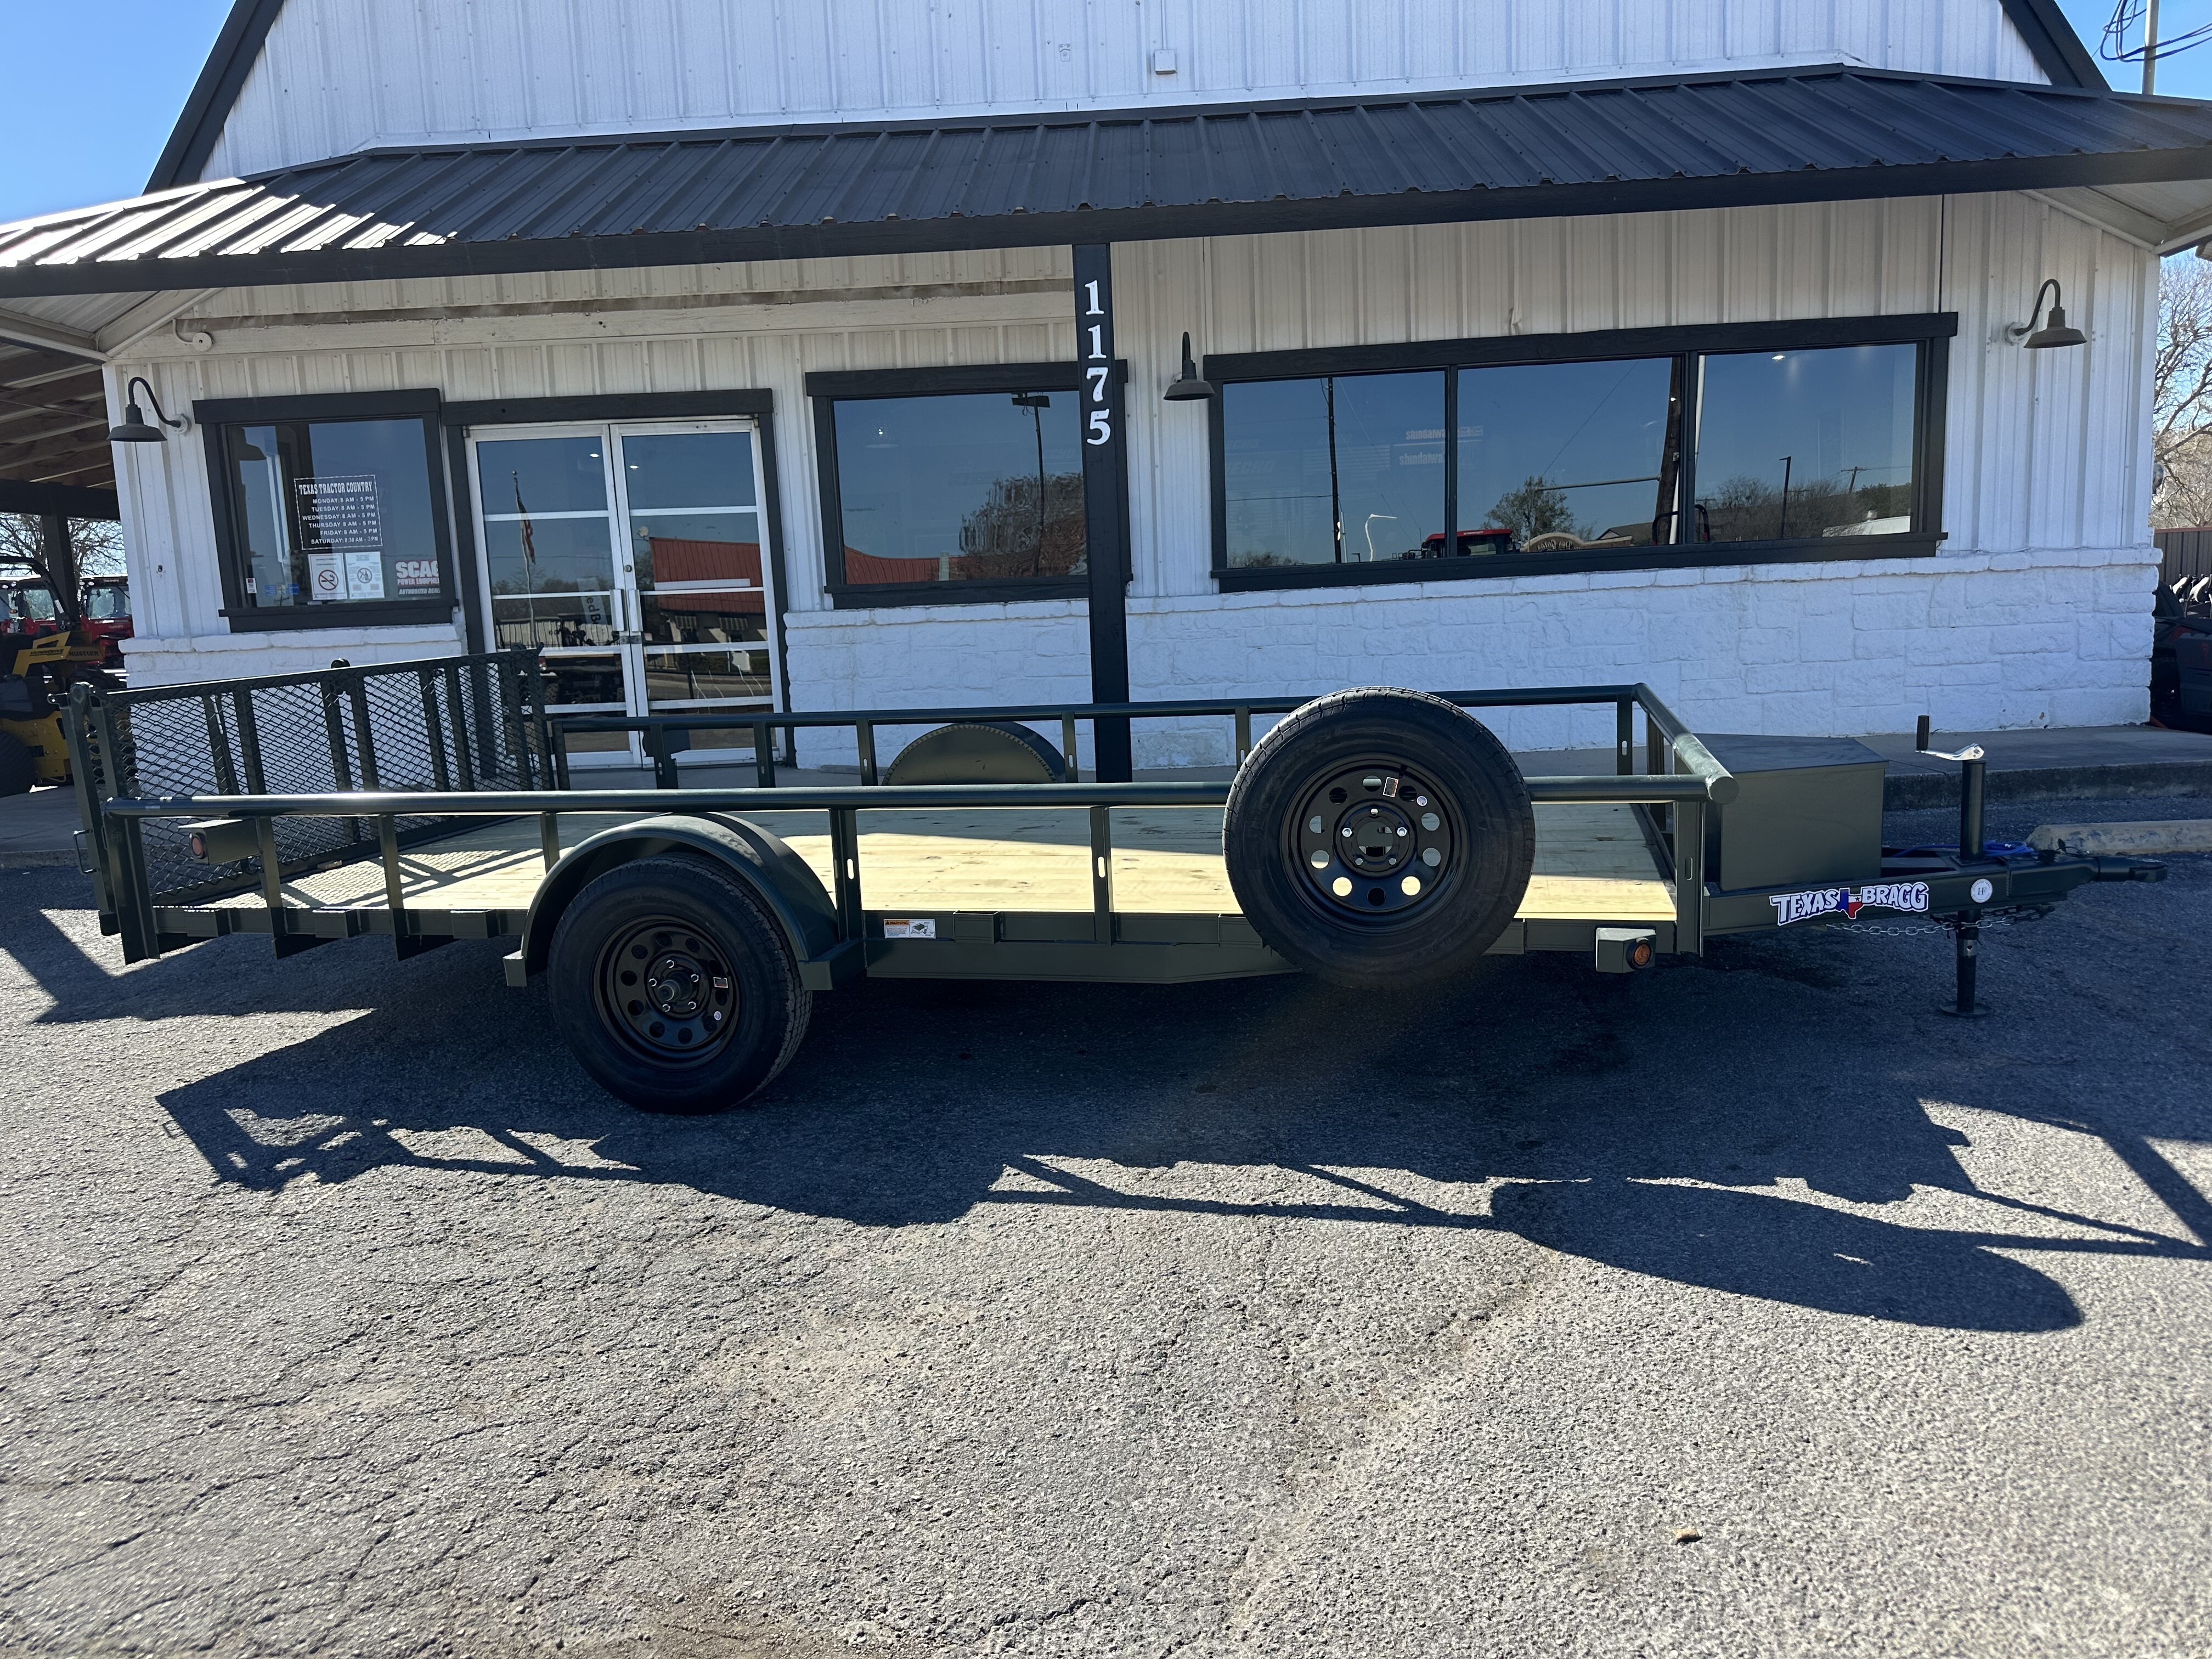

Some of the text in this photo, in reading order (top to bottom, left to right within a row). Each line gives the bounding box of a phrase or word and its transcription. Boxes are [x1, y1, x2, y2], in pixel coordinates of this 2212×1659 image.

[1084, 280, 1110, 445] 1175
[298, 481, 372, 495] TEXAS TRACTOR COUNTRY
[1770, 882, 1928, 926] TEXAS BRAGG
